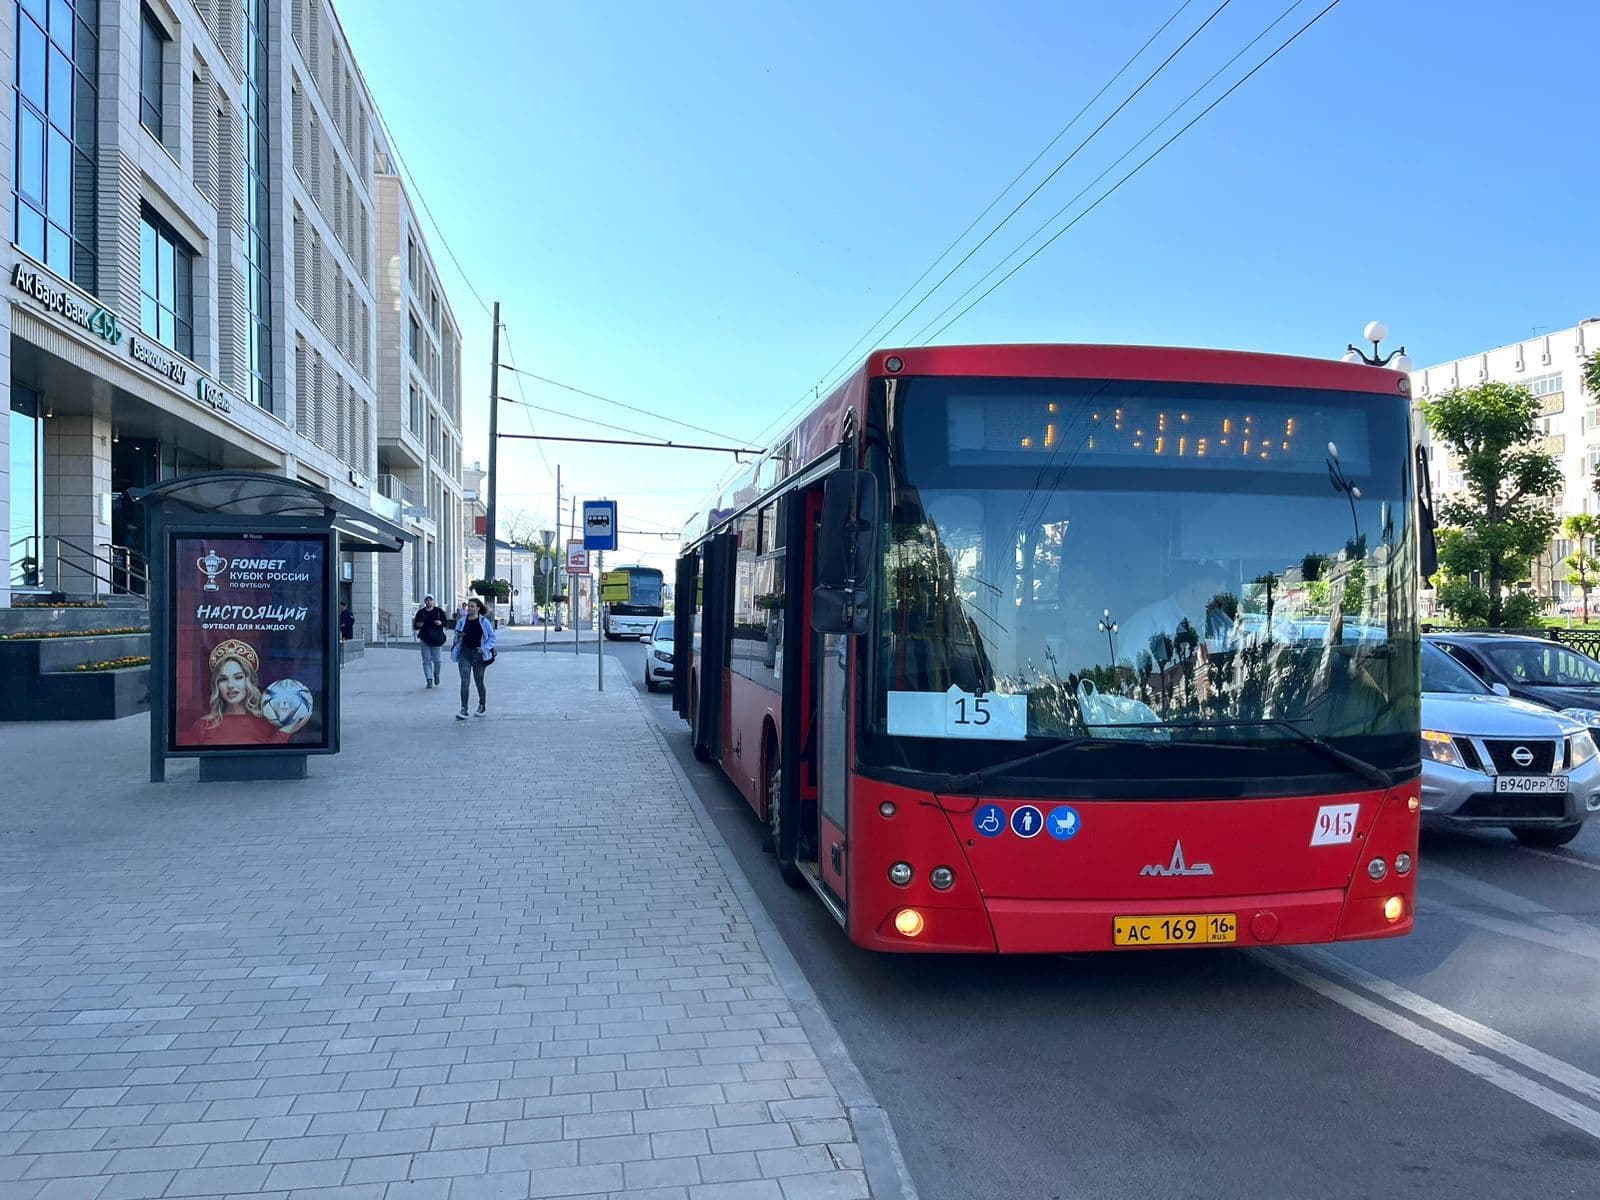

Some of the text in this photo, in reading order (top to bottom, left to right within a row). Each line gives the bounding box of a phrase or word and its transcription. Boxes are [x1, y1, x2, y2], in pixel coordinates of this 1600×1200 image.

[12, 262, 91, 329] Ак Барс Банк
[130, 337, 170, 378] Банкомат
[230, 558, 286, 570] FONBET
[303, 552, 317, 561] 6+
[229, 571, 309, 582] КУБОК РОССИИ
[236, 623, 253, 631] ДЛЯ
[255, 623, 296, 631] КАЖДОГО
[954, 697, 991, 726] 15
[1319, 812, 1353, 836] 945
[1160, 919, 1197, 941] 169
[1210, 917, 1229, 934] 16
